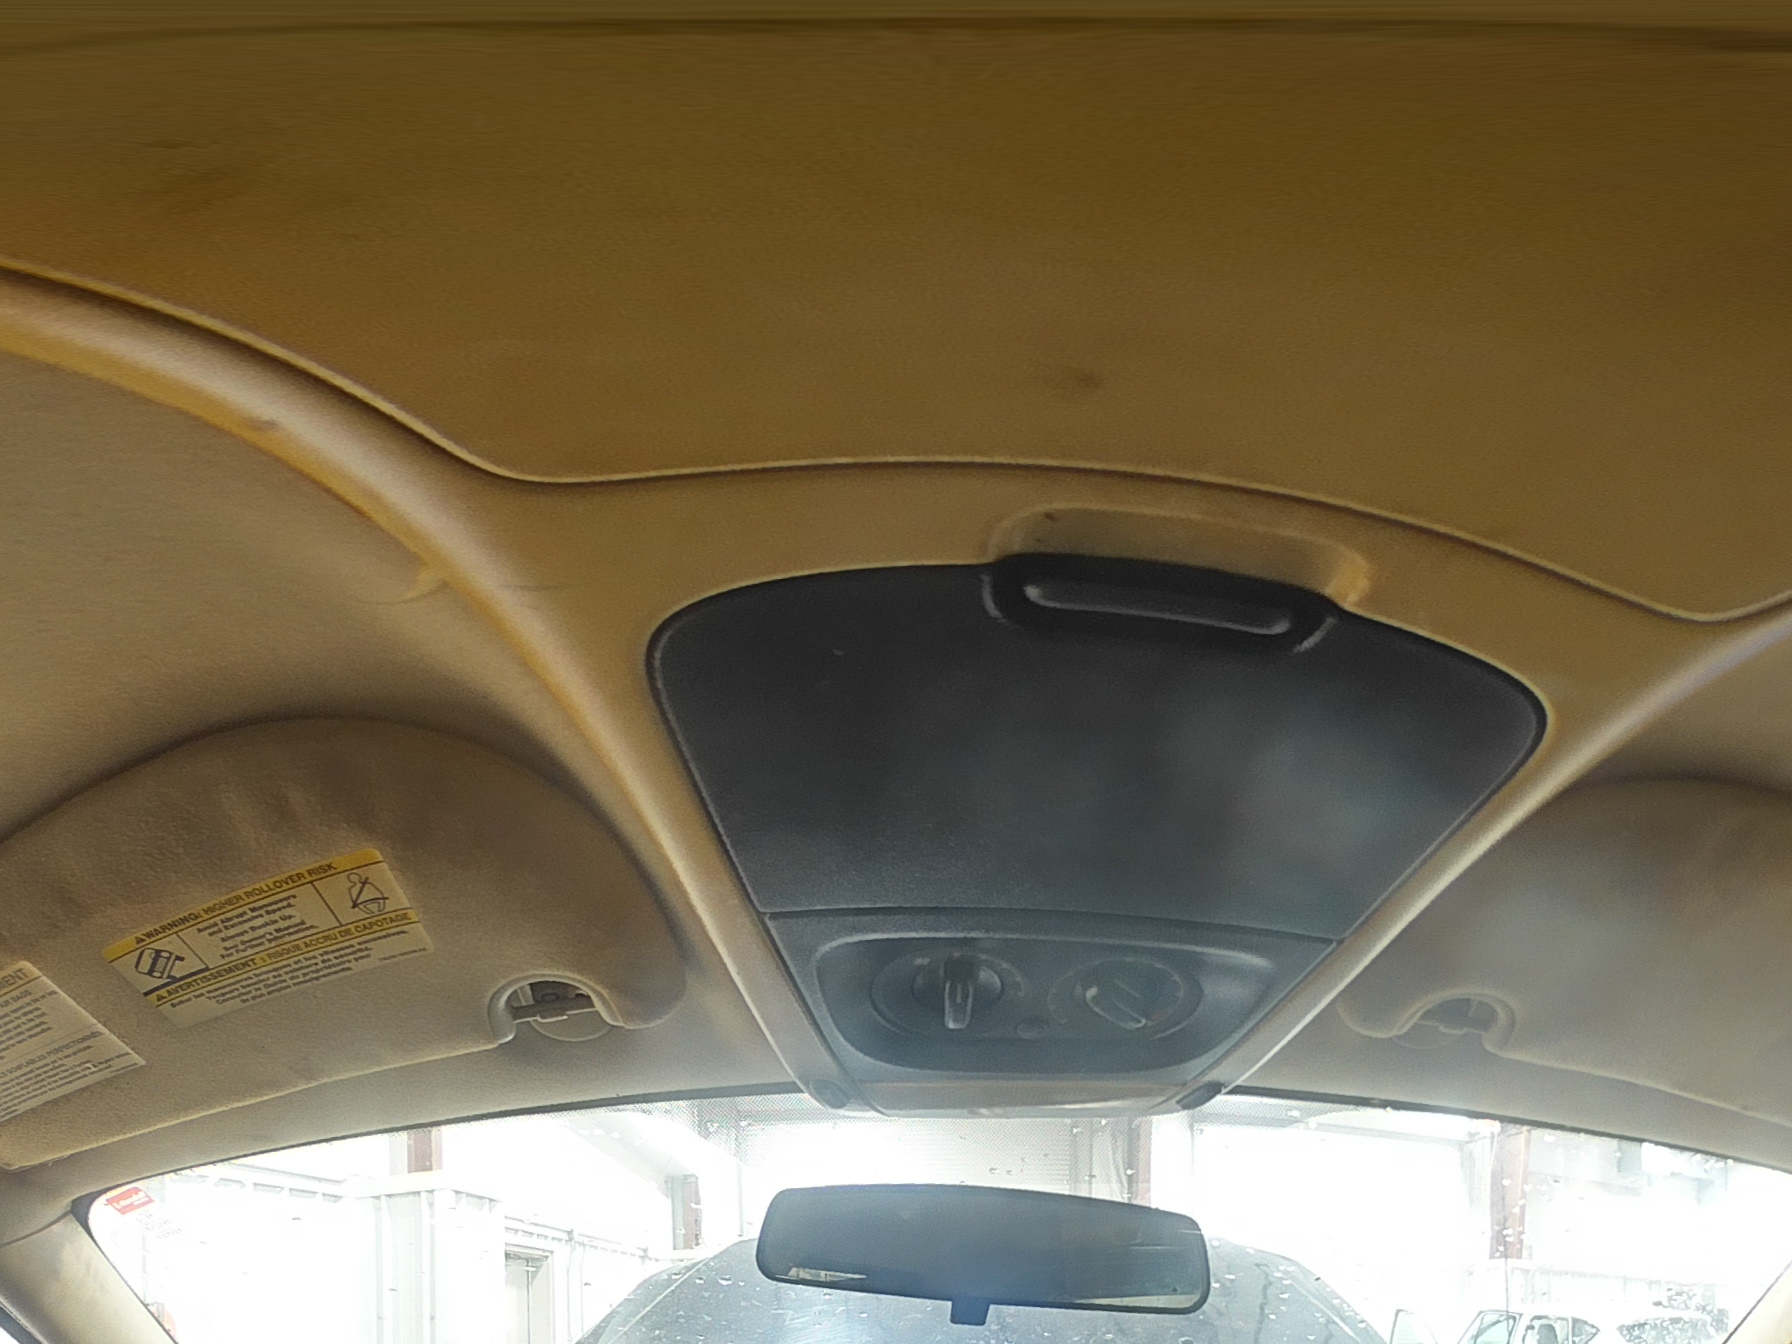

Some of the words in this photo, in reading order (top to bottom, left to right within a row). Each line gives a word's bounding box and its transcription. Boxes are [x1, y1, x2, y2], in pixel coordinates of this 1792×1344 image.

[202, 895, 243, 915] HIGHER
[243, 872, 306, 899] ROLLOVER
[306, 862, 337, 877] RISK
[166, 958, 257, 997] AVERTISSEMENT
[266, 943, 303, 960] RISQUE
[303, 932, 338, 949] ACCRU
[337, 928, 353, 938] DE
[354, 912, 411, 933] CAPOTAGE
